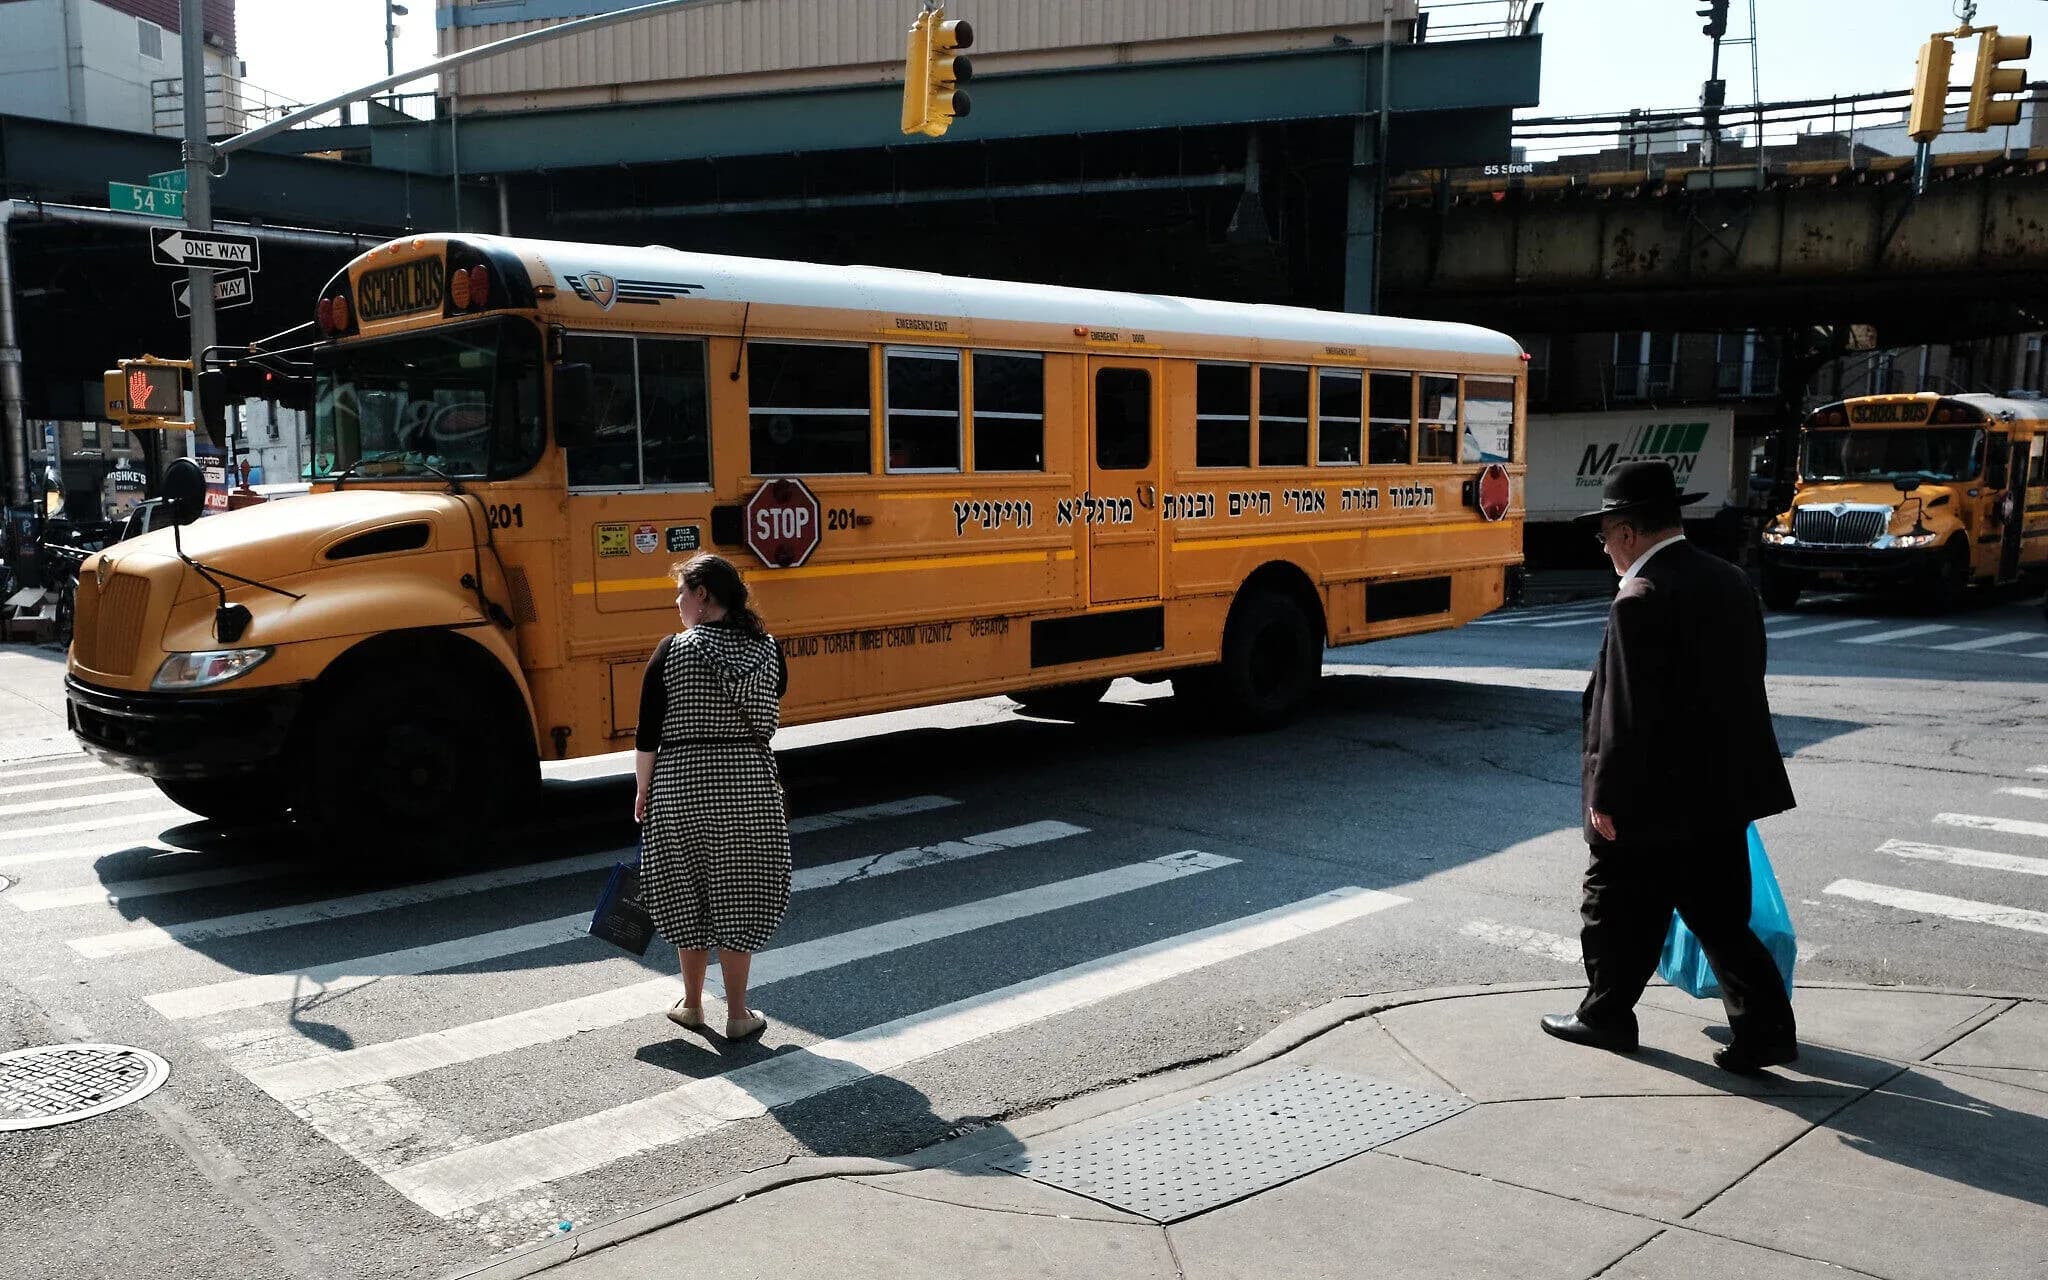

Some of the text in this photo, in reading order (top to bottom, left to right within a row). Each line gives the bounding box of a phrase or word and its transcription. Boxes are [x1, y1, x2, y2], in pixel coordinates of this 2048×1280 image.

[1484, 163, 1533, 175] 55 Street
[133, 187, 176, 211] 54 ST
[184, 241, 247, 260] ONE WAY
[219, 280, 242, 297] WAY
[361, 256, 443, 318] SCHOOL BUS
[896, 318, 948, 332] EMERGENCY EXIT
[1090, 331, 1146, 344] EMERGENCY DOOR
[1854, 402, 1927, 424] SCHOOL BUS
[1577, 443, 1698, 476] MON
[490, 502, 524, 529] 201
[828, 508, 856, 531] 201
[953, 481, 1434, 537] תלמוד תורה אמרי חיים ובנות מרגליא וויזניץ
[756, 506, 809, 540] STOP
[780, 616, 1010, 657] TALMUD TORAH IMREI CHAIM VIZNITZ OPERATOR
